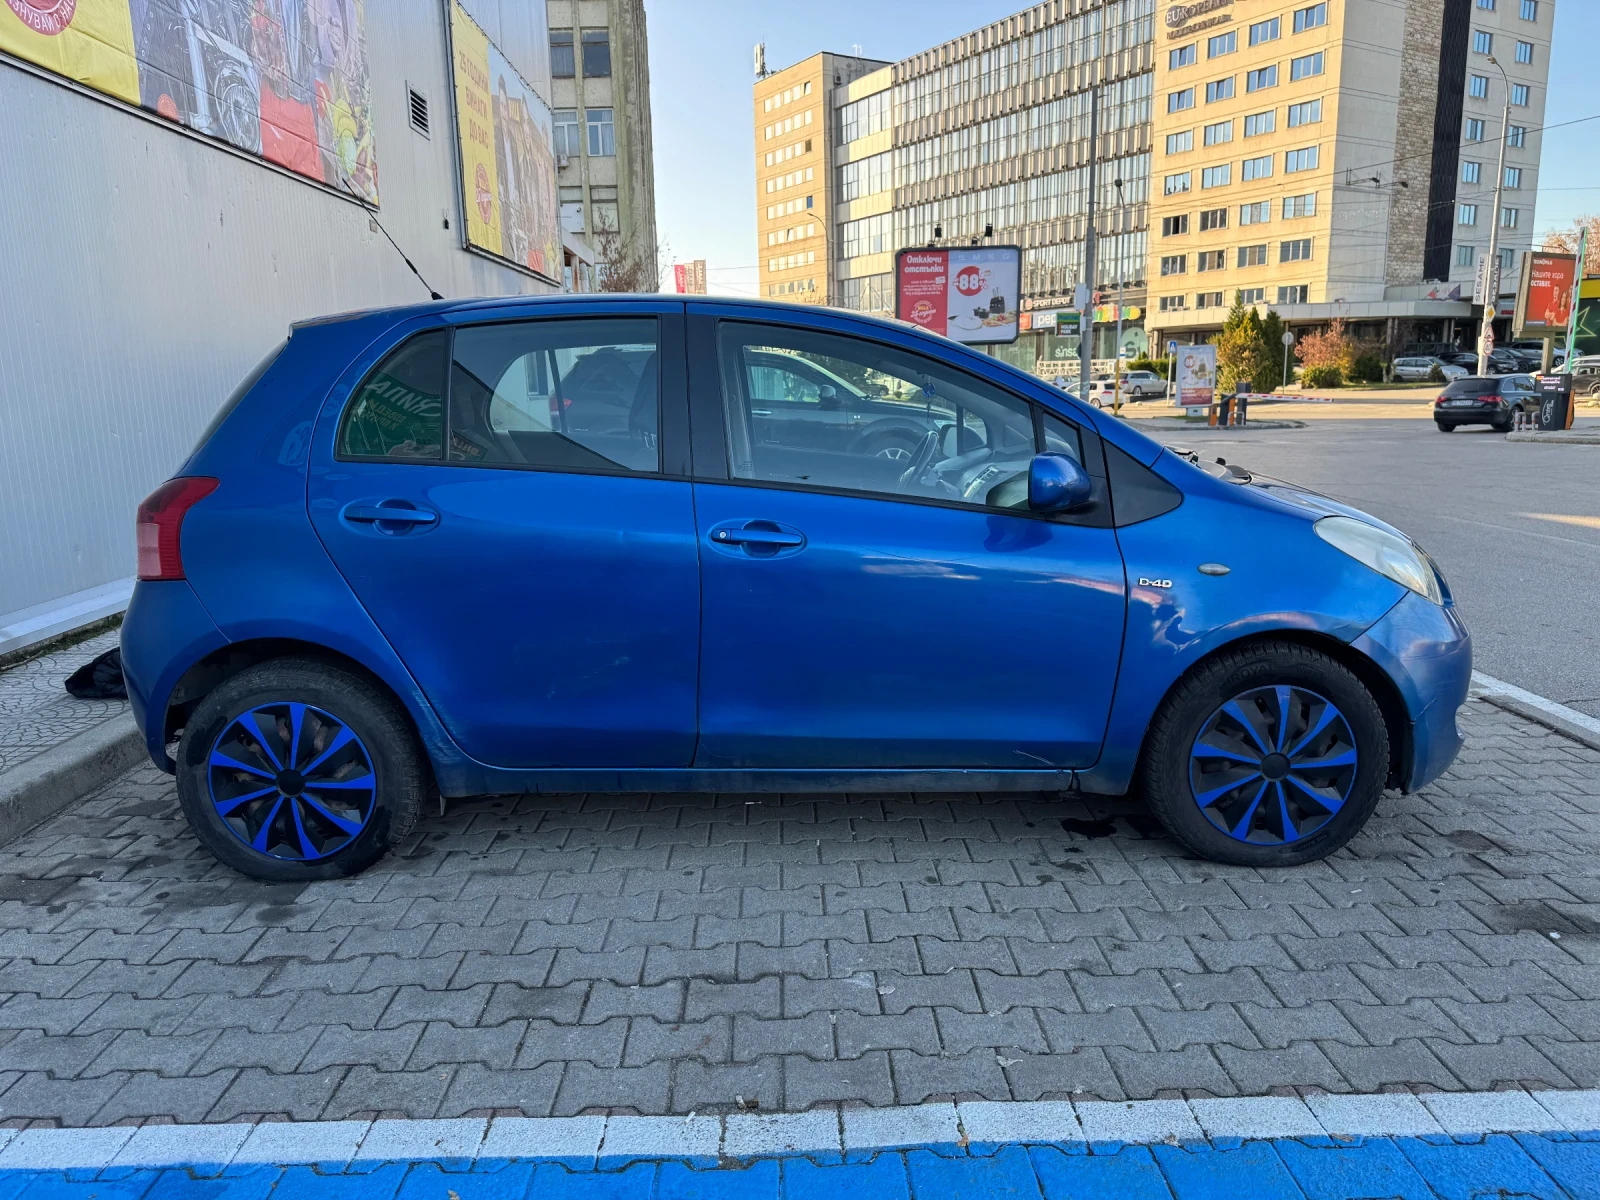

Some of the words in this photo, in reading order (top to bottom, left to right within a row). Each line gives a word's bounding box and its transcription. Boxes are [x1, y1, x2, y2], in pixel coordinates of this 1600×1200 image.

[9, 0, 55, 31] ЗНУВАЙ
[906, 255, 942, 264] Отключи
[904, 264, 944, 273] отстъпки
[1475, 256, 1484, 302] SESAME
[1032, 299, 1051, 307] SPORT
[1052, 297, 1071, 305] DEPOT
[1138, 577, 1173, 588] D-4D
